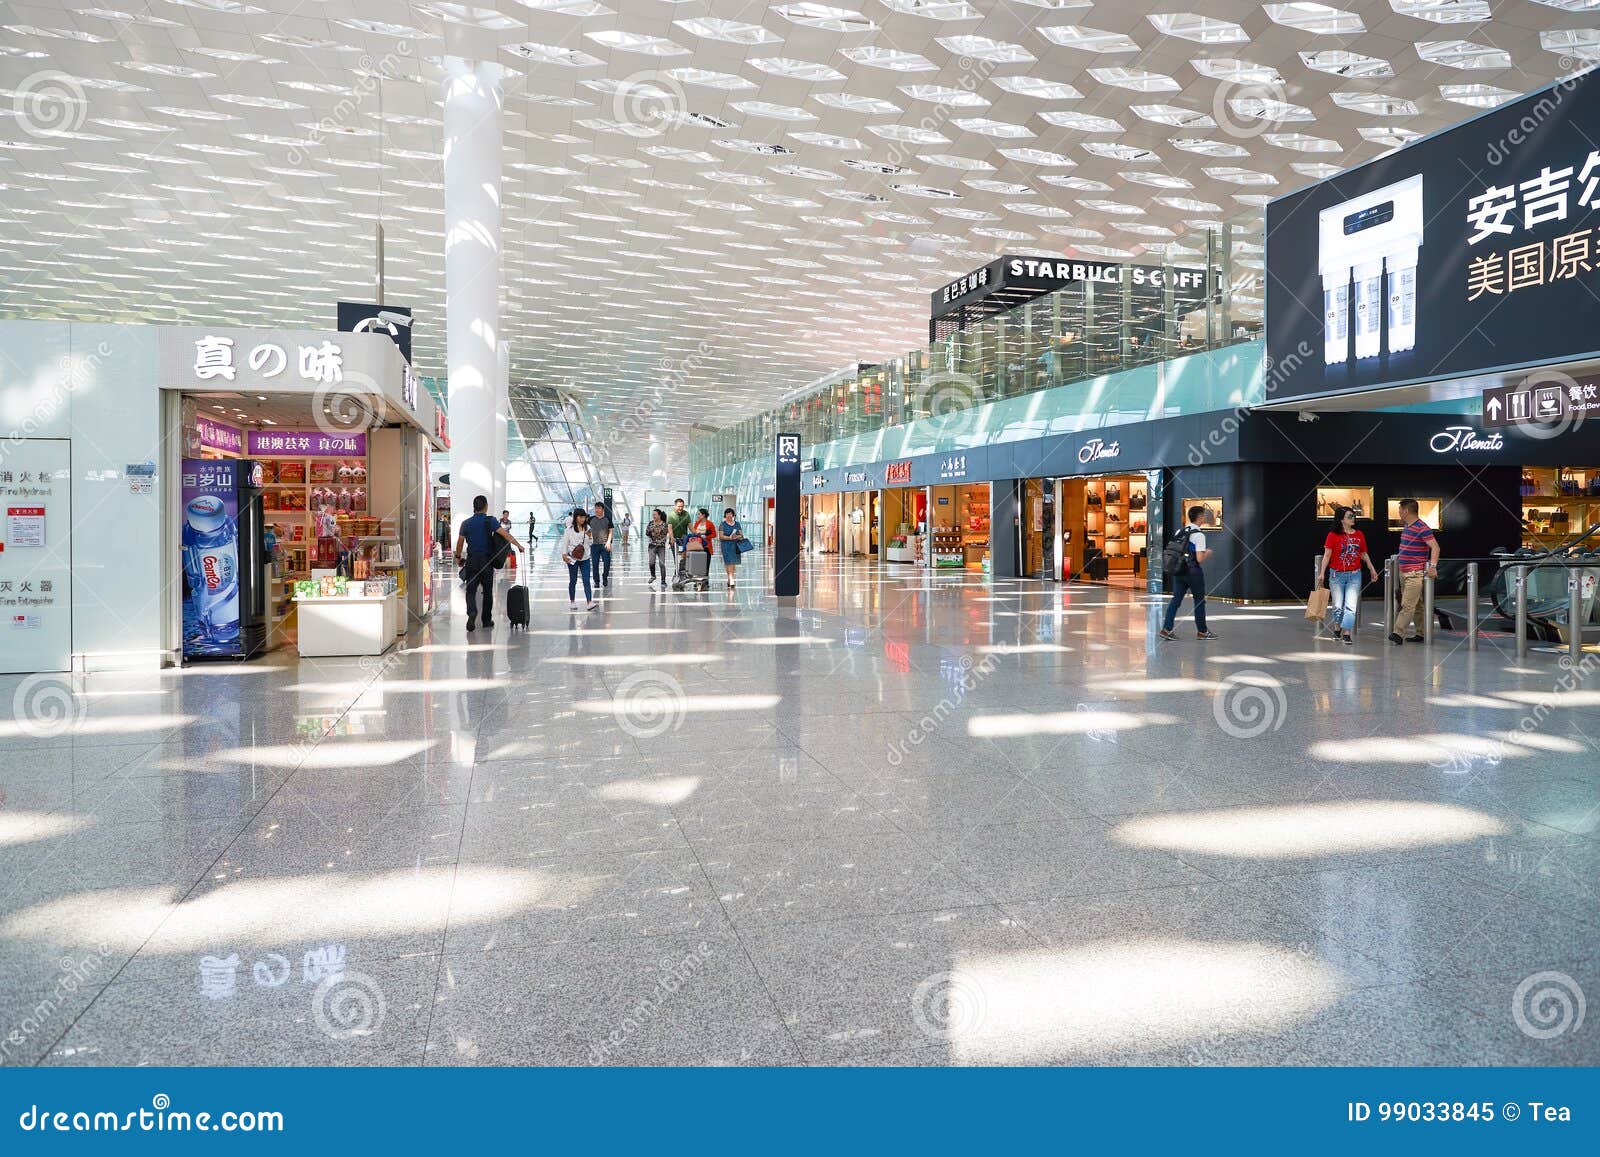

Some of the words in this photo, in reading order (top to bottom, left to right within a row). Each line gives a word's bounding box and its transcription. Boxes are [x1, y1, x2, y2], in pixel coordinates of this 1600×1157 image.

[1467, 226, 1600, 302] 美国原
[194, 335, 343, 383] 真の味
[319, 437, 357, 451] 真の味
[183, 473, 232, 487] 百岁山
